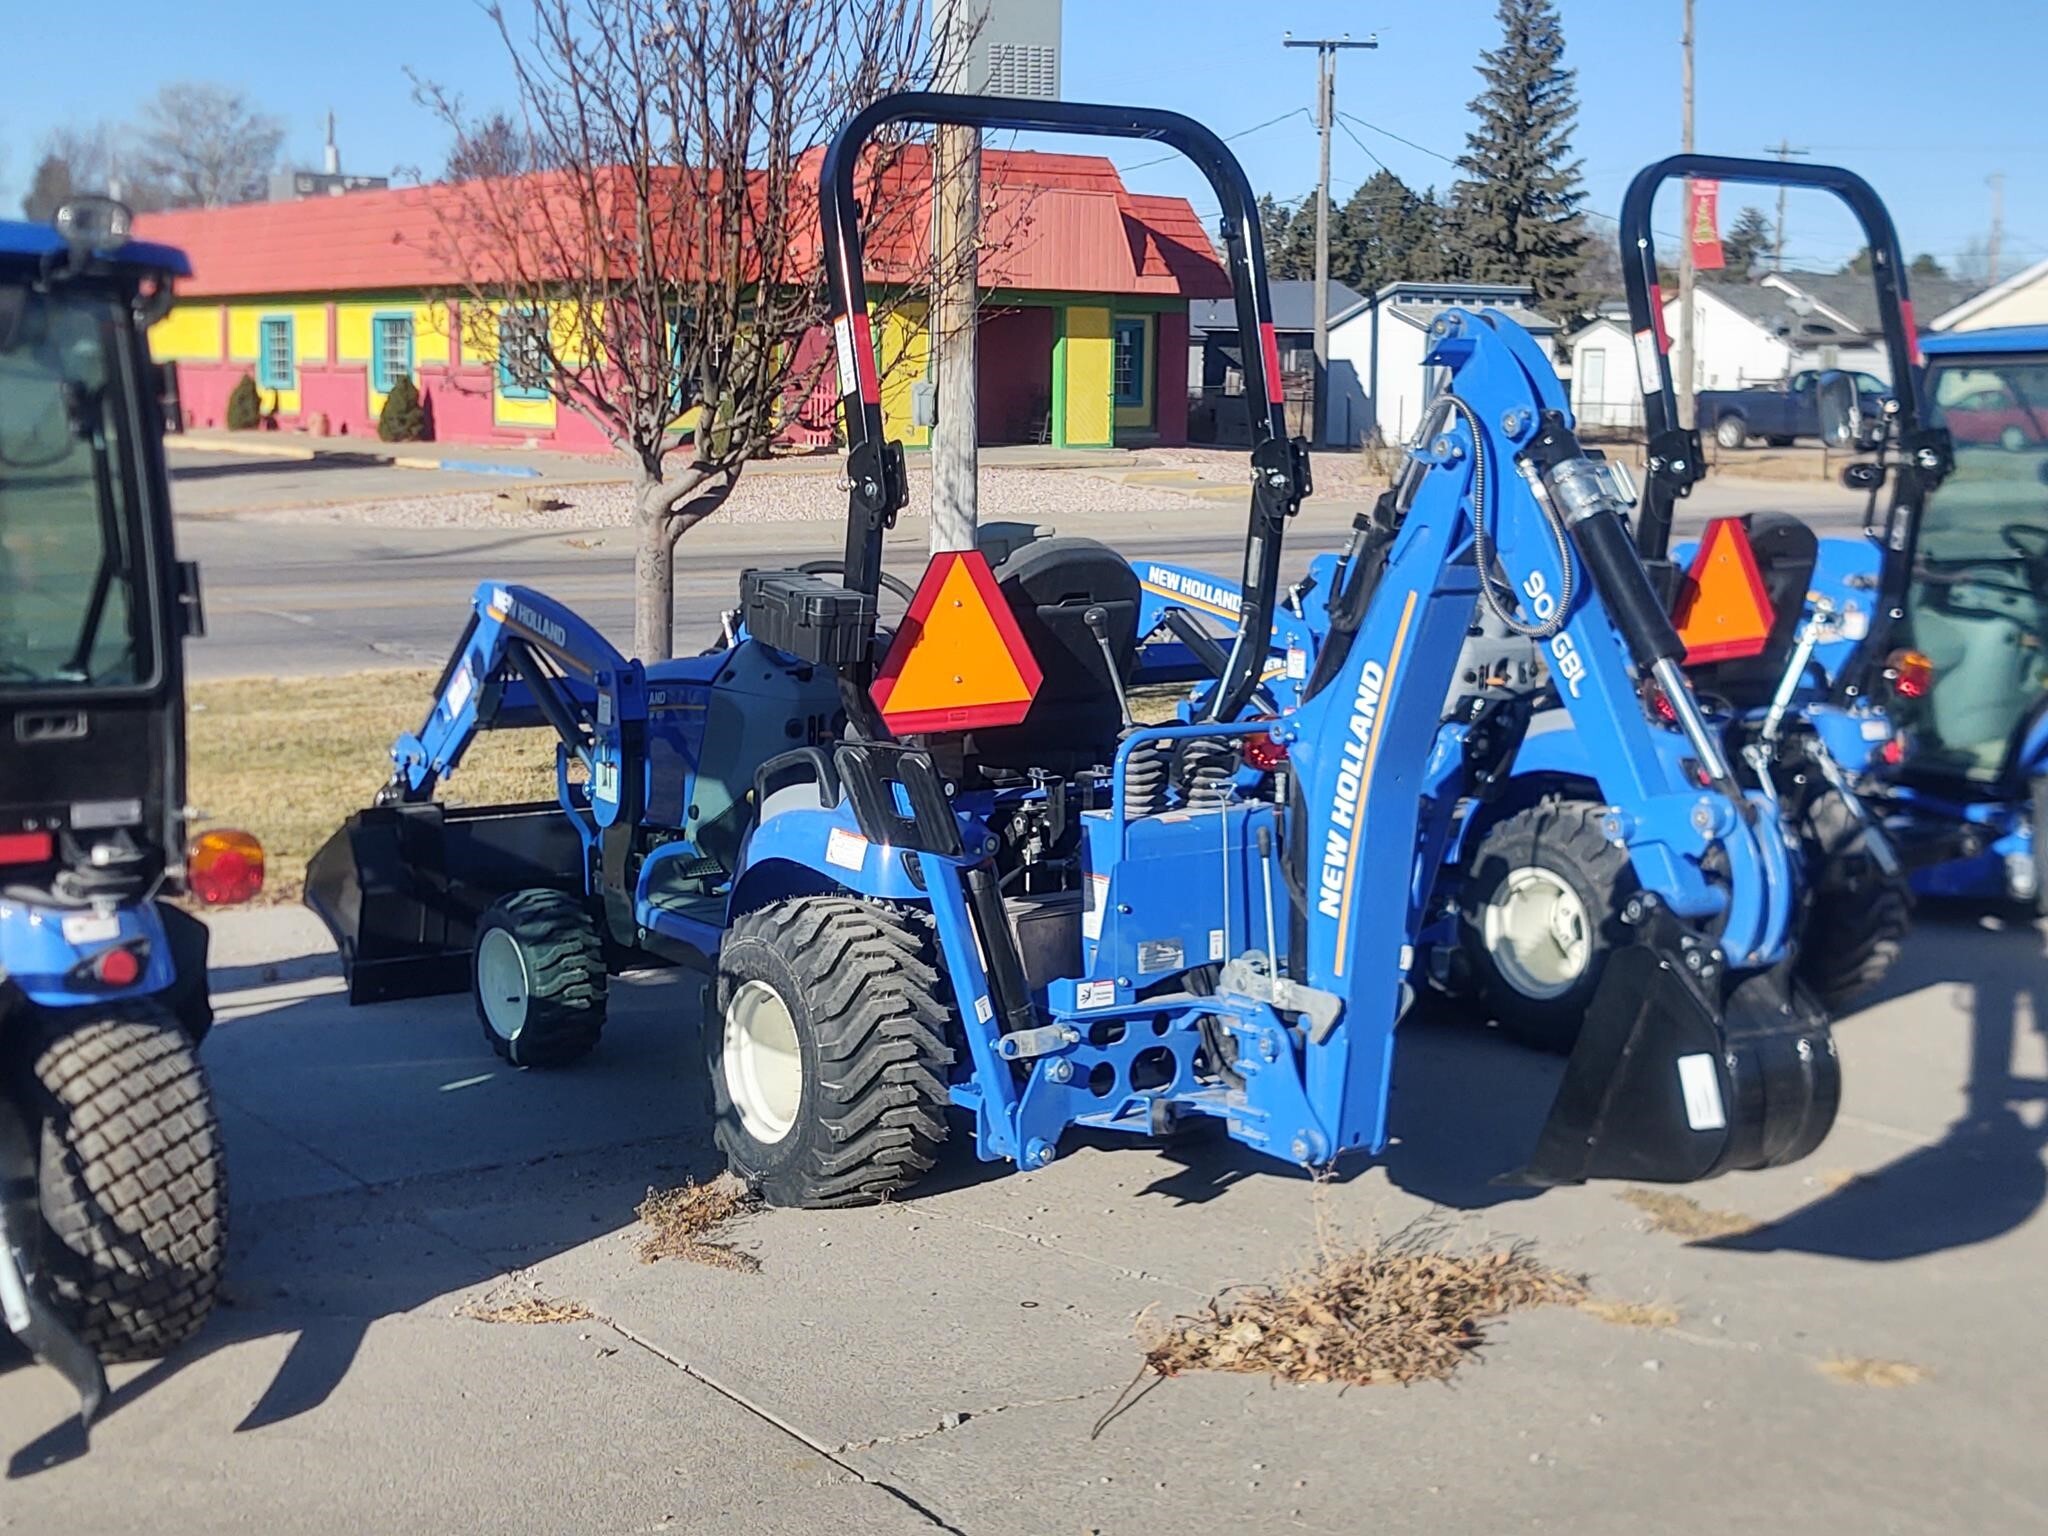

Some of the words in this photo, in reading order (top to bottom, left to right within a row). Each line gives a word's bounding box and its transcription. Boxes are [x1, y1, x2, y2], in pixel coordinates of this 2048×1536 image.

[1147, 565, 1181, 591] NEW
[1180, 576, 1243, 613] HOLLAND
[518, 602, 566, 648] HOLLAND
[1330, 659, 1386, 830] HOLLAND
[1318, 828, 1351, 919] NEW
